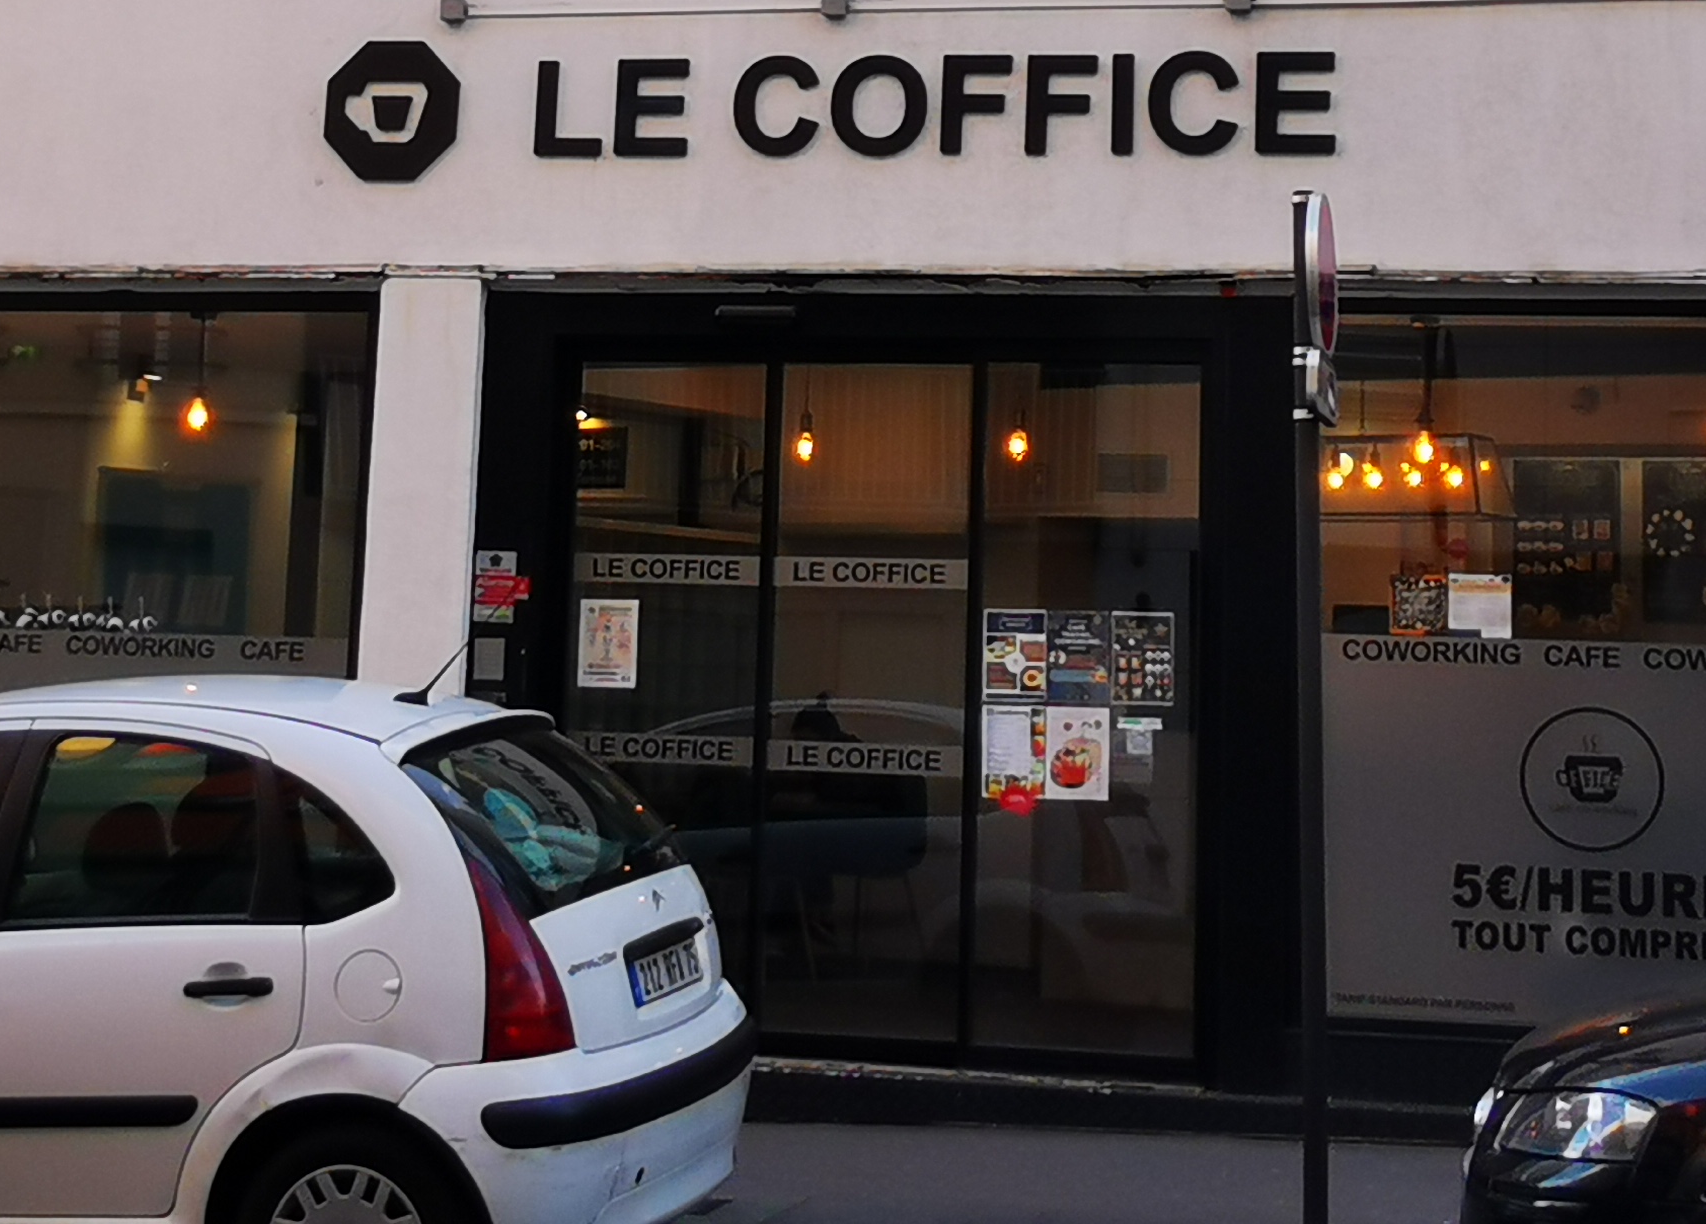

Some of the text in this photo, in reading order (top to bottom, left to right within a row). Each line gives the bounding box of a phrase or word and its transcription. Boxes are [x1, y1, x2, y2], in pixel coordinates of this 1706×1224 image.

[533, 50, 1337, 158] LE COFFICE
[592, 558, 741, 580] LE COFFICE
[793, 561, 947, 584] LE COFFICE
[65, 634, 215, 659] COWORKING
[240, 640, 305, 662] CAFE
[1341, 639, 1522, 666] COWORKING
[1543, 644, 1621, 669] CAFE
[583, 737, 734, 761] LE COFFICE
[786, 745, 943, 771] LE COFFICE
[1451, 920, 1551, 954] TOUT
